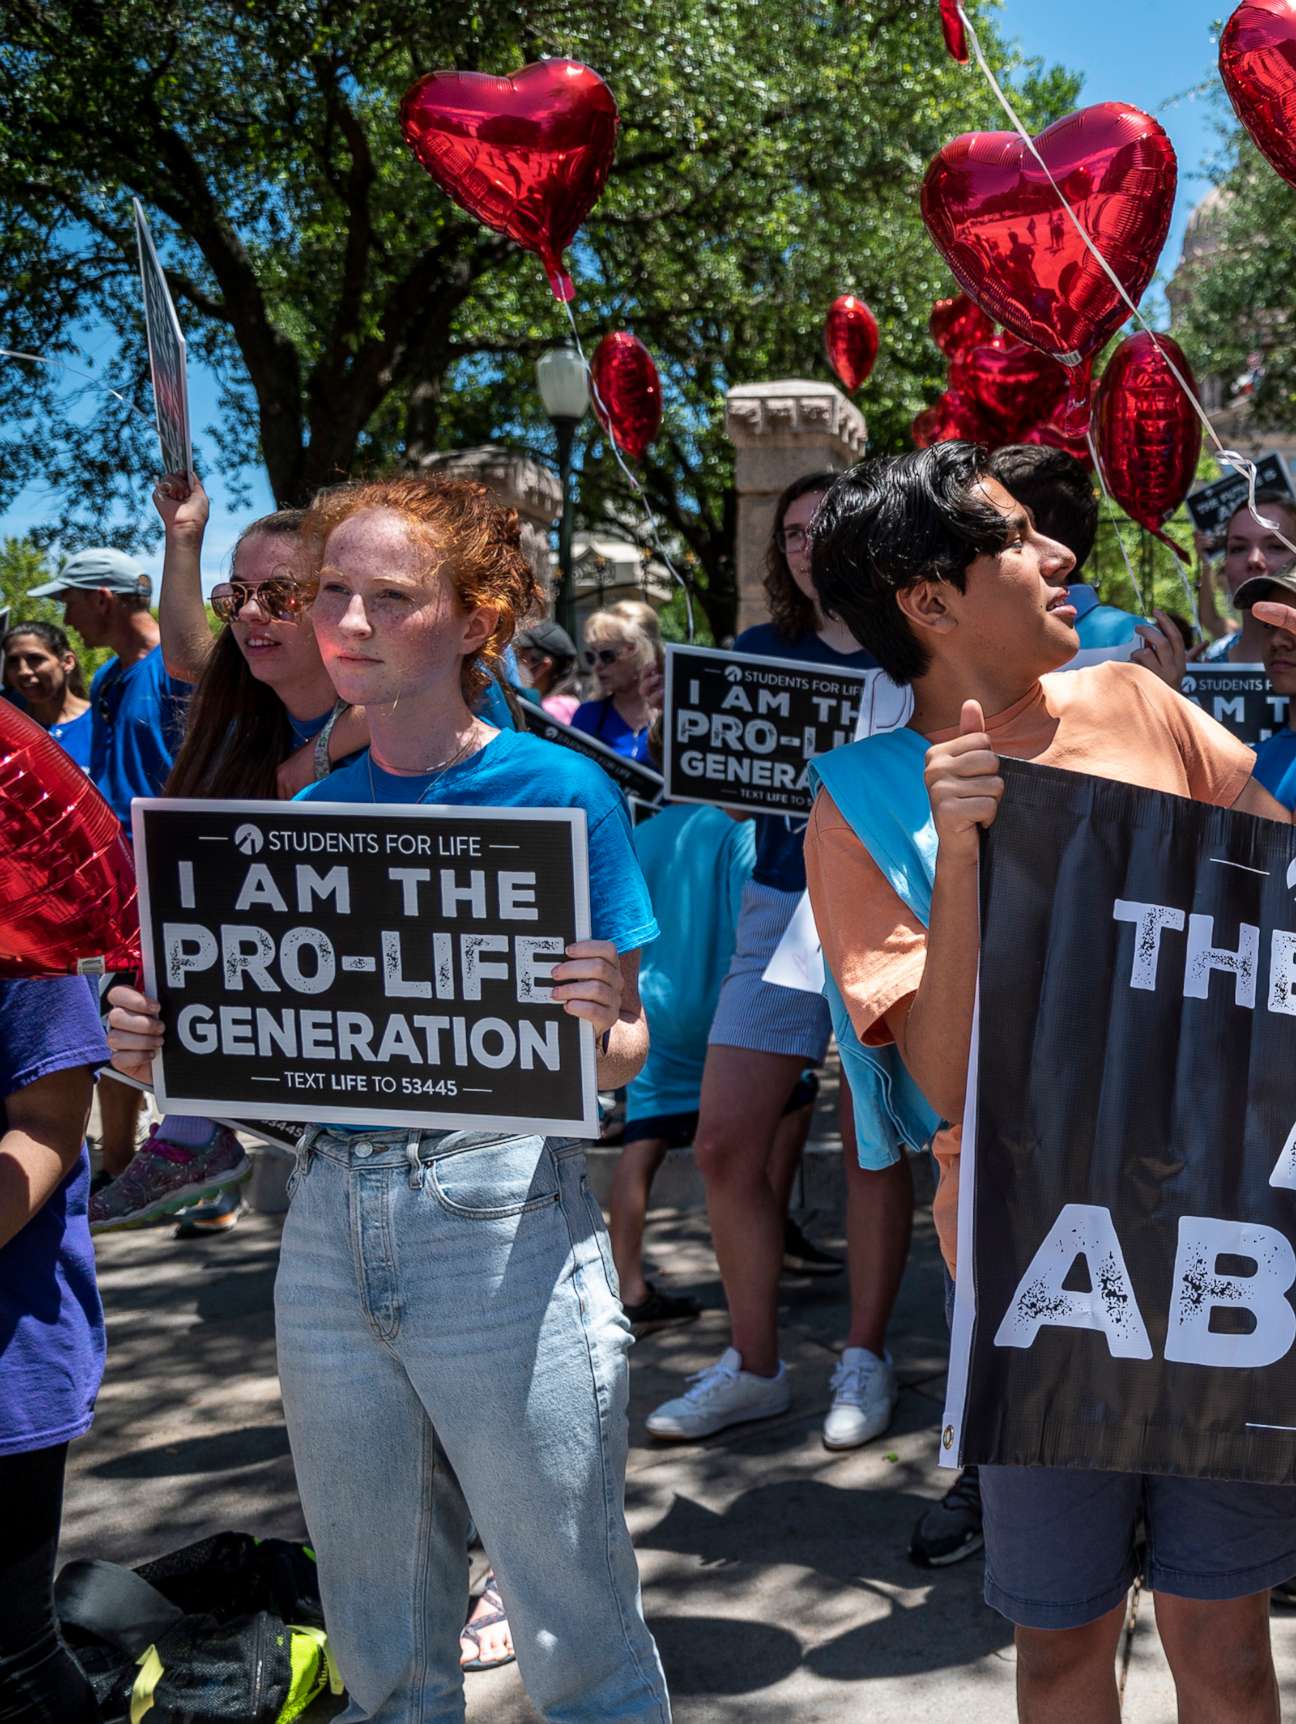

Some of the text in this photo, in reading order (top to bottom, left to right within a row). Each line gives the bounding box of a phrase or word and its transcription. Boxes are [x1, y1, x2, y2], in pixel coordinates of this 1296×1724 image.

[744, 671, 864, 697] STUDENTS FOR LIF
[1200, 679, 1263, 691] STUDENTS
[689, 679, 859, 726] I AM TH
[680, 751, 809, 790] GENERA
[740, 788, 764, 799] TEXT
[766, 791, 788, 803] LIFE
[790, 794, 806, 805] TO
[268, 830, 482, 857] STUDENTS FOR LIFE
[178, 860, 539, 921] I AM THE
[162, 923, 566, 1004] PRO-LIFE
[177, 1004, 560, 1071] GENERATION
[284, 1071, 457, 1097] TEXT LIFE TO 53445
